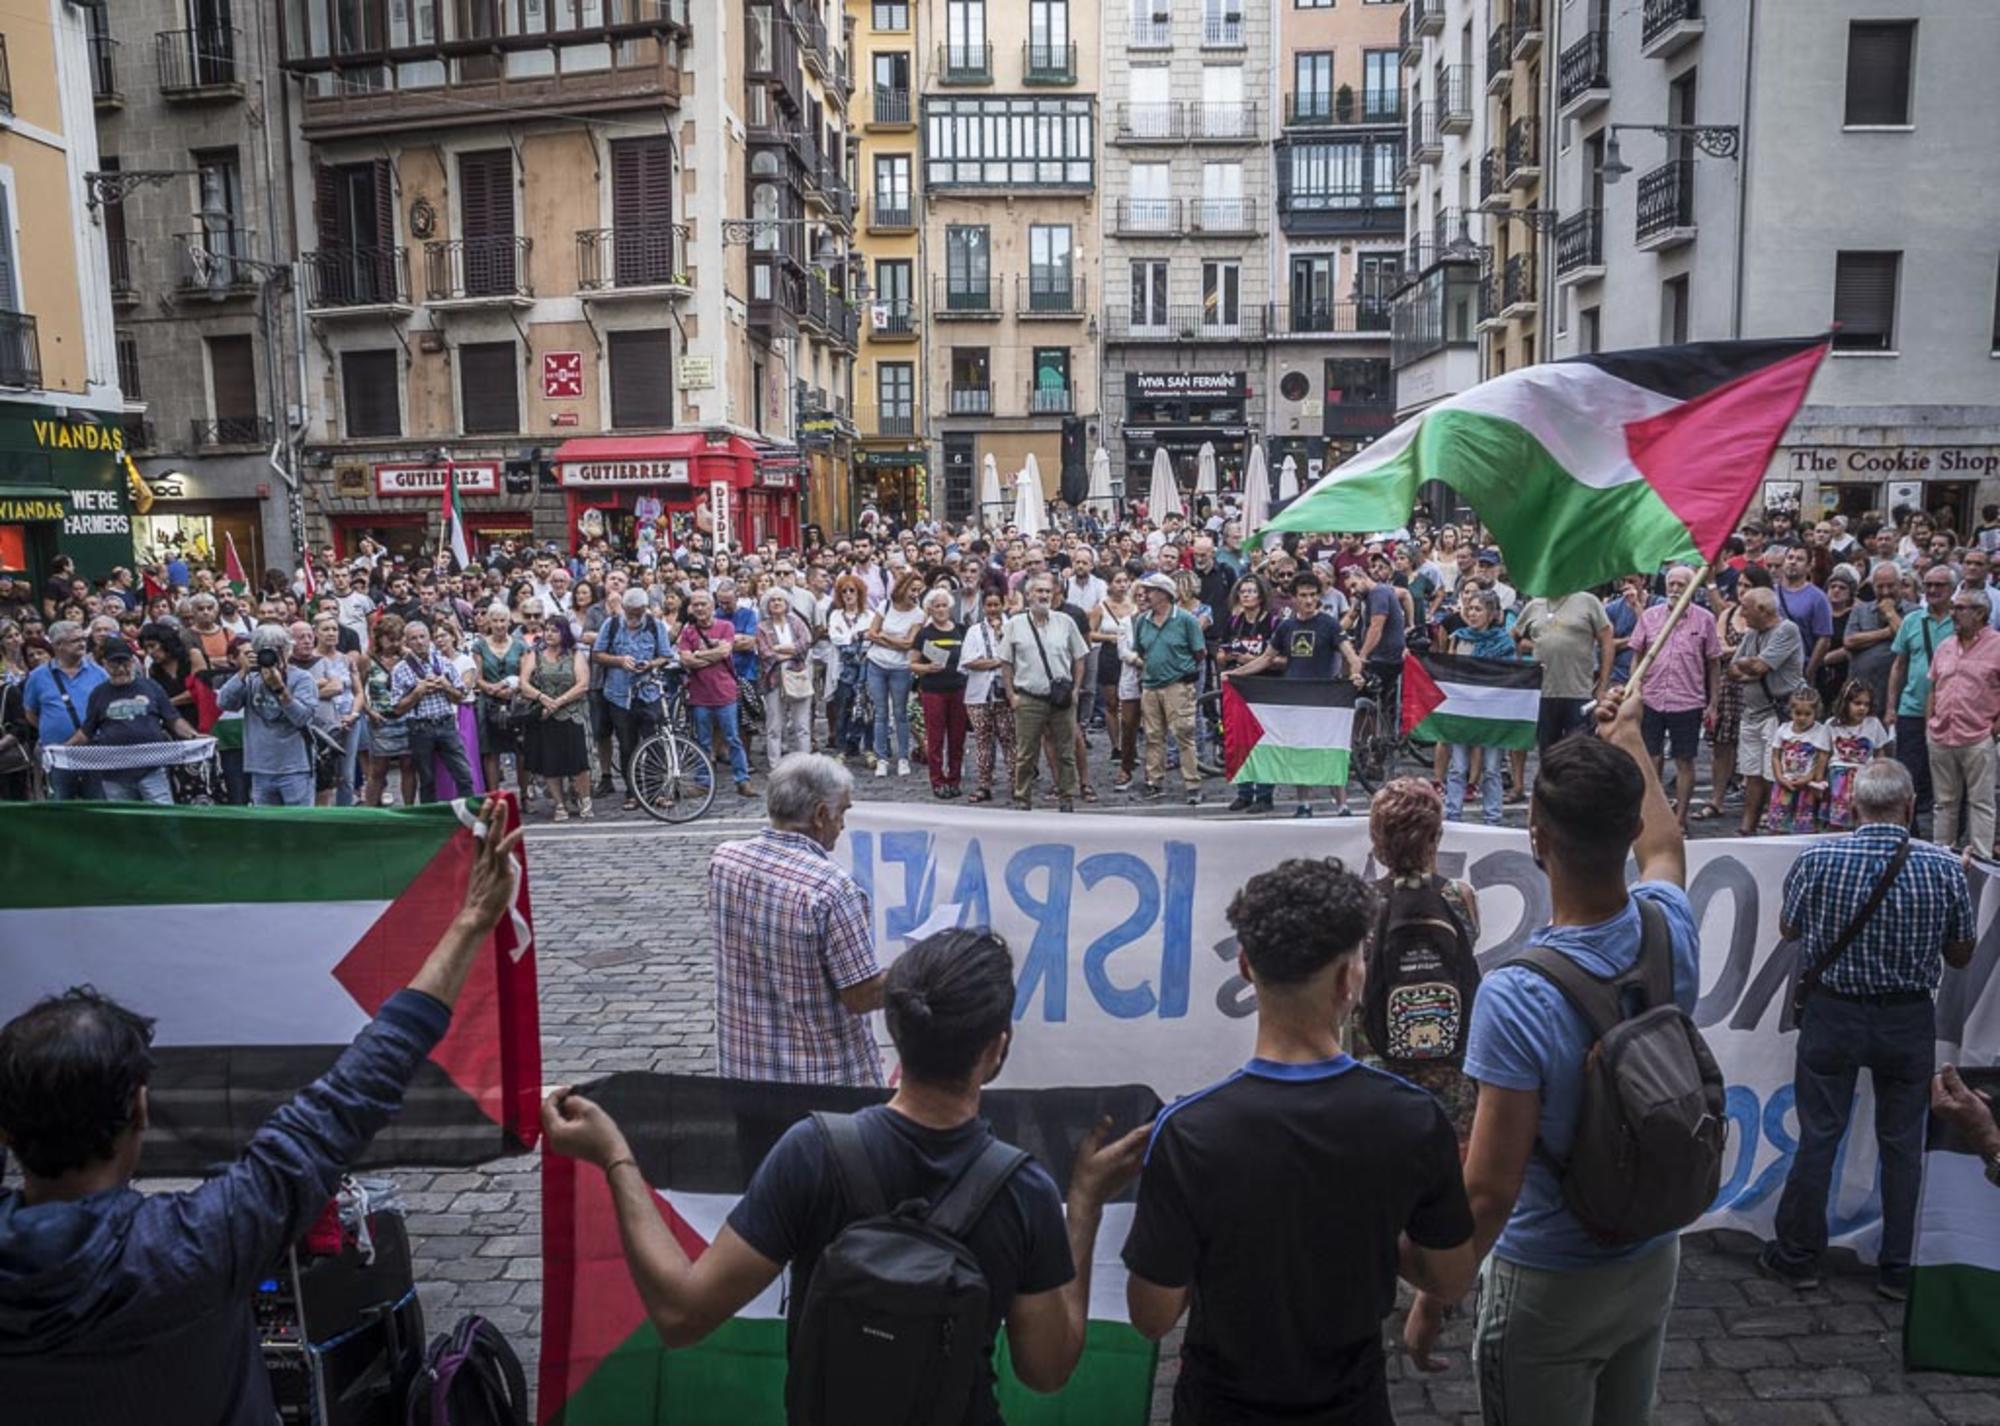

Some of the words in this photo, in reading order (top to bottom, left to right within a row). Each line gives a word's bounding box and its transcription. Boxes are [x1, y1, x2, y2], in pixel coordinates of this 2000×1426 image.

[1168, 376, 1190, 387] SAN
[33, 420, 123, 450] VIANDAS
[579, 464, 672, 480] GUTIERREZ
[1790, 451, 1837, 471] The
[1847, 451, 1931, 472] Cookie
[1940, 450, 2000, 475] Shop
[64, 515, 129, 534] FARMERS
[716, 487, 725, 543] DESDE
